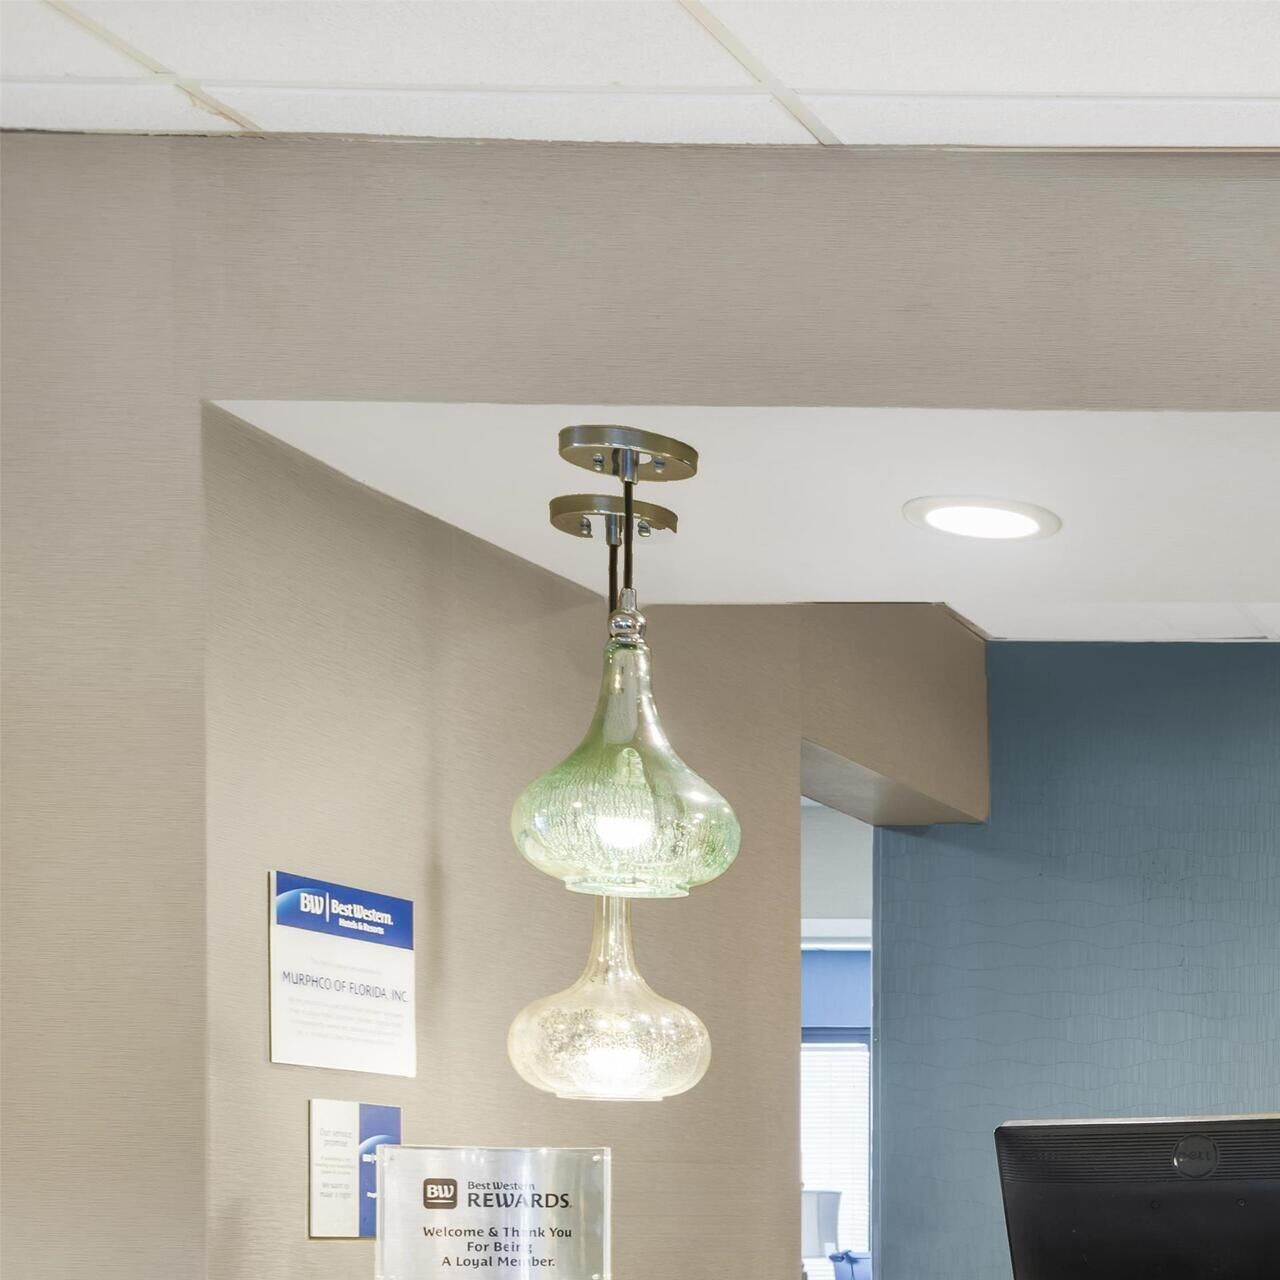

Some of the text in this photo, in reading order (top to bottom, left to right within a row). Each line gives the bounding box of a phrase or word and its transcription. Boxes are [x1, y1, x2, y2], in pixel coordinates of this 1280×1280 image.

[300, 893, 324, 915] BW
[331, 899, 353, 917] Best
[282, 970, 332, 991] MURPHCO
[334, 978, 347, 993] OF
[426, 1181, 535, 1199] BW Best Westn
[423, 1226, 572, 1238] Welcome & Thnk You
[467, 1241, 533, 1254] For Bei
[442, 1256, 451, 1267] A
[456, 1256, 492, 1269] Loyal
